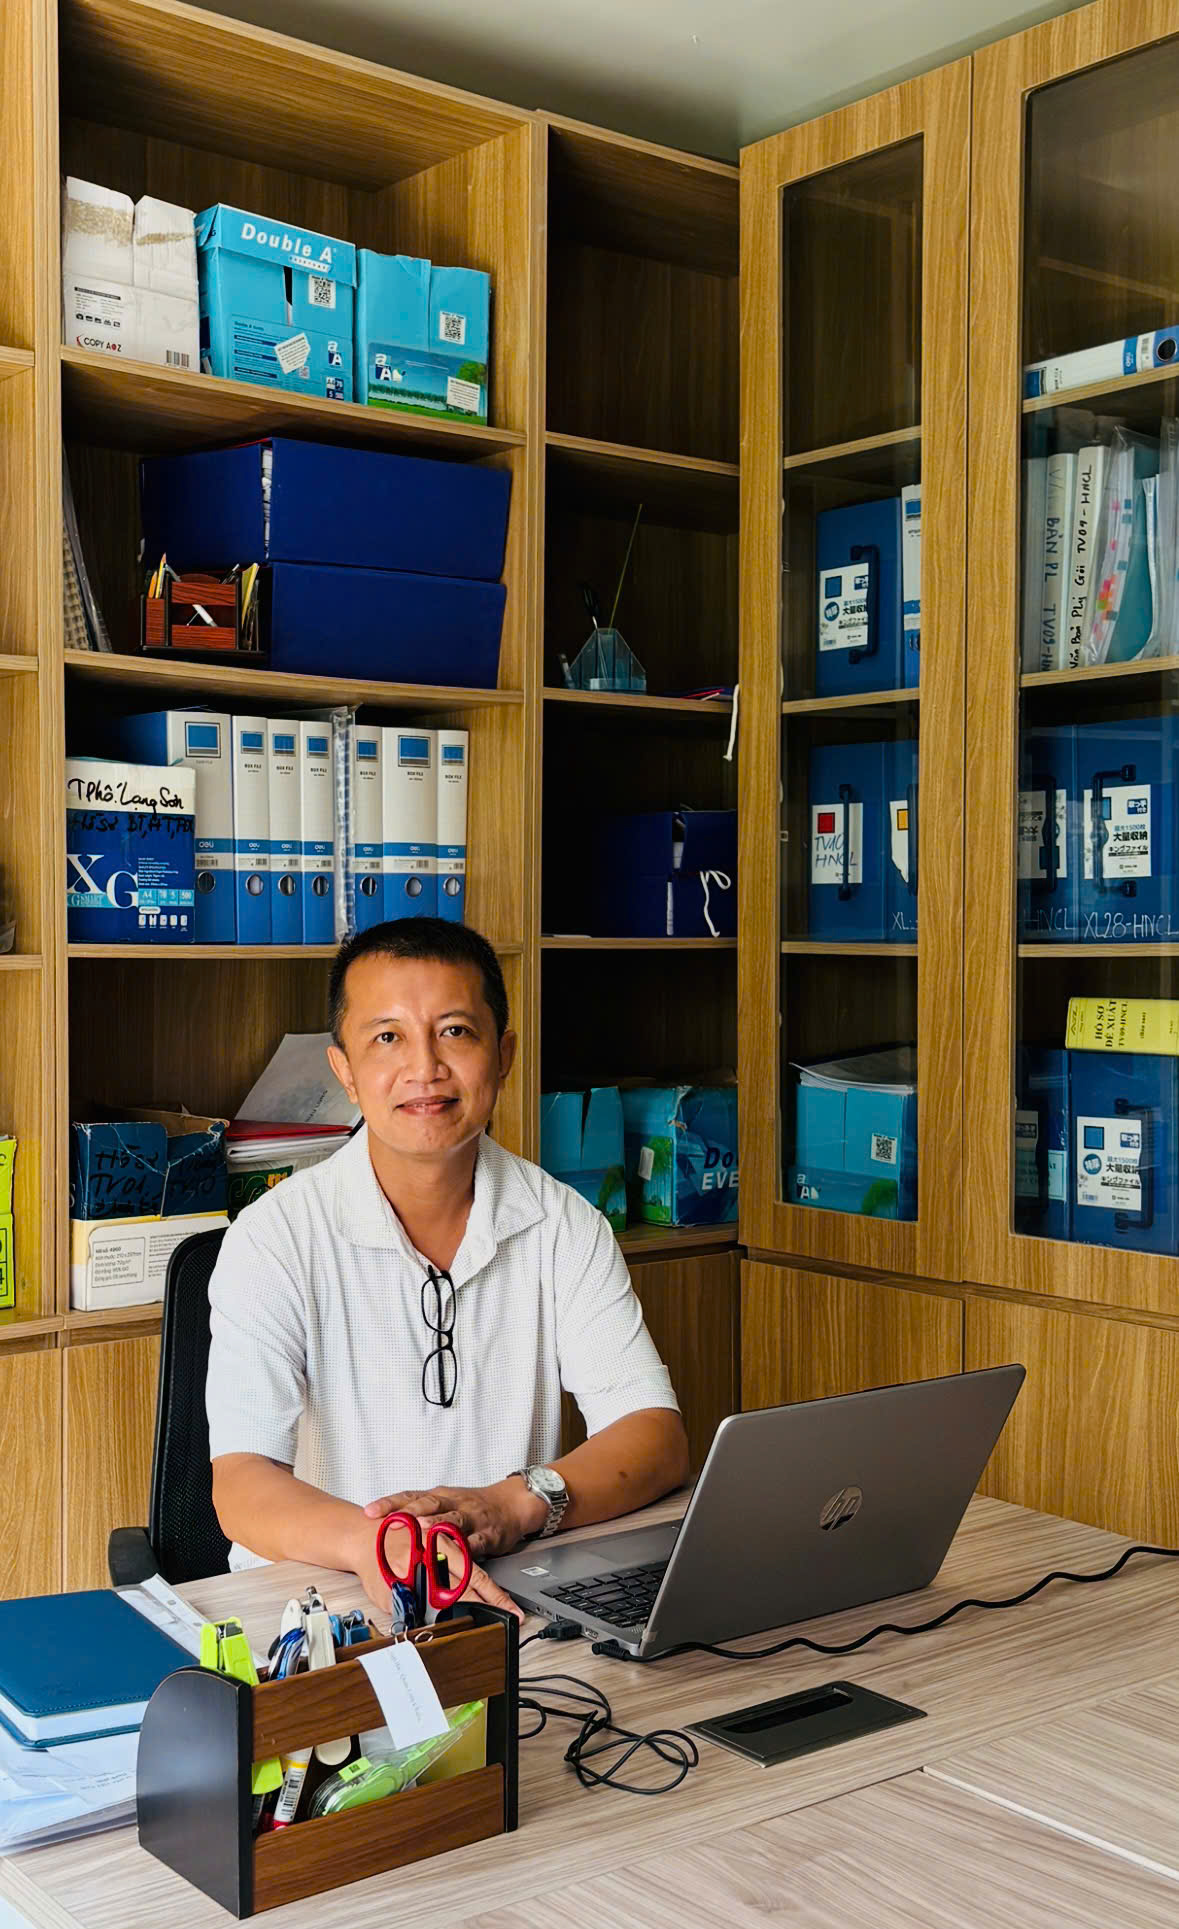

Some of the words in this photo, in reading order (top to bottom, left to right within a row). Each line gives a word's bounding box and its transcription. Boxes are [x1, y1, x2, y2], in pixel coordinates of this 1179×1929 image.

[241, 222, 312, 257] Double
[319, 246, 333, 264] A
[83, 336, 104, 349] COPY
[1081, 464, 1092, 504] HNCL
[1077, 520, 1088, 554] TV09
[1083, 911, 1179, 939] XL28-HNCL
[704, 1147, 738, 1169] Do
